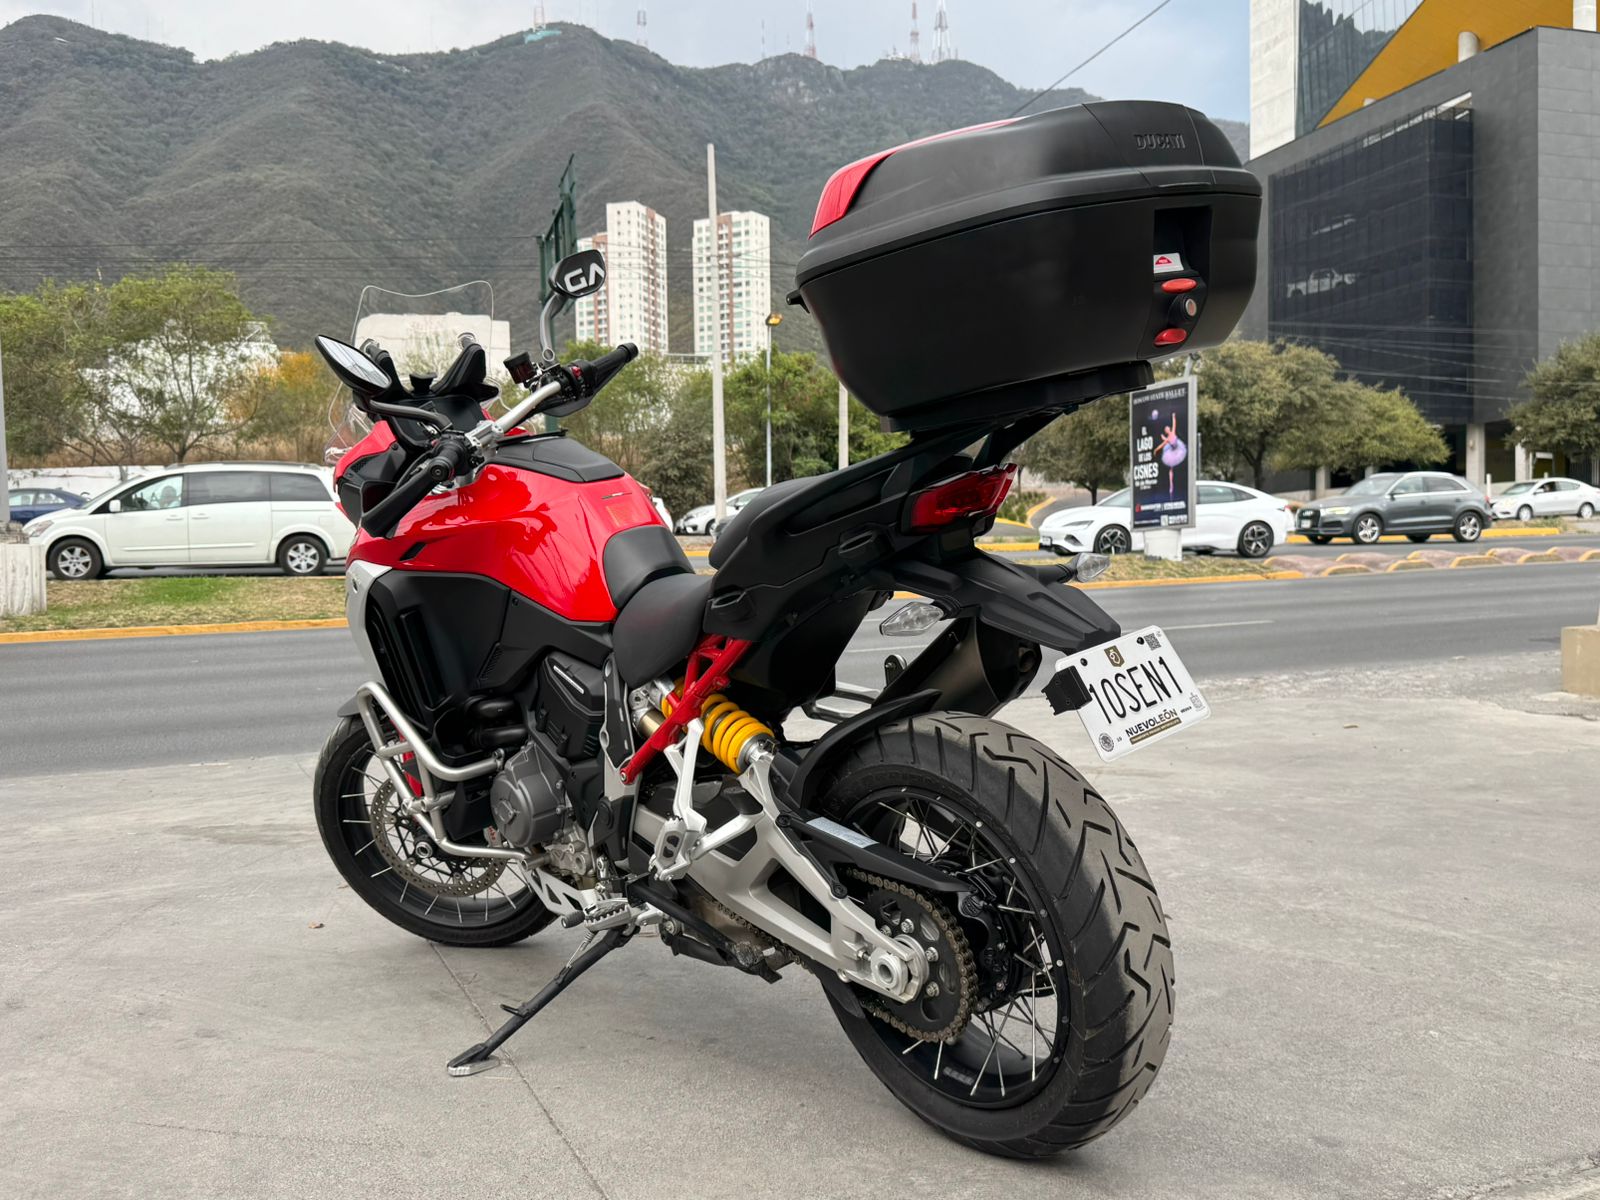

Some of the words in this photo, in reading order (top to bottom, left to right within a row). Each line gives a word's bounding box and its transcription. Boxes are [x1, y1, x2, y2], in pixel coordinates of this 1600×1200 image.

[1133, 133, 1185, 150] DUCATI
[1137, 436, 1153, 452] LAGO
[1134, 462, 1159, 479] CISNES
